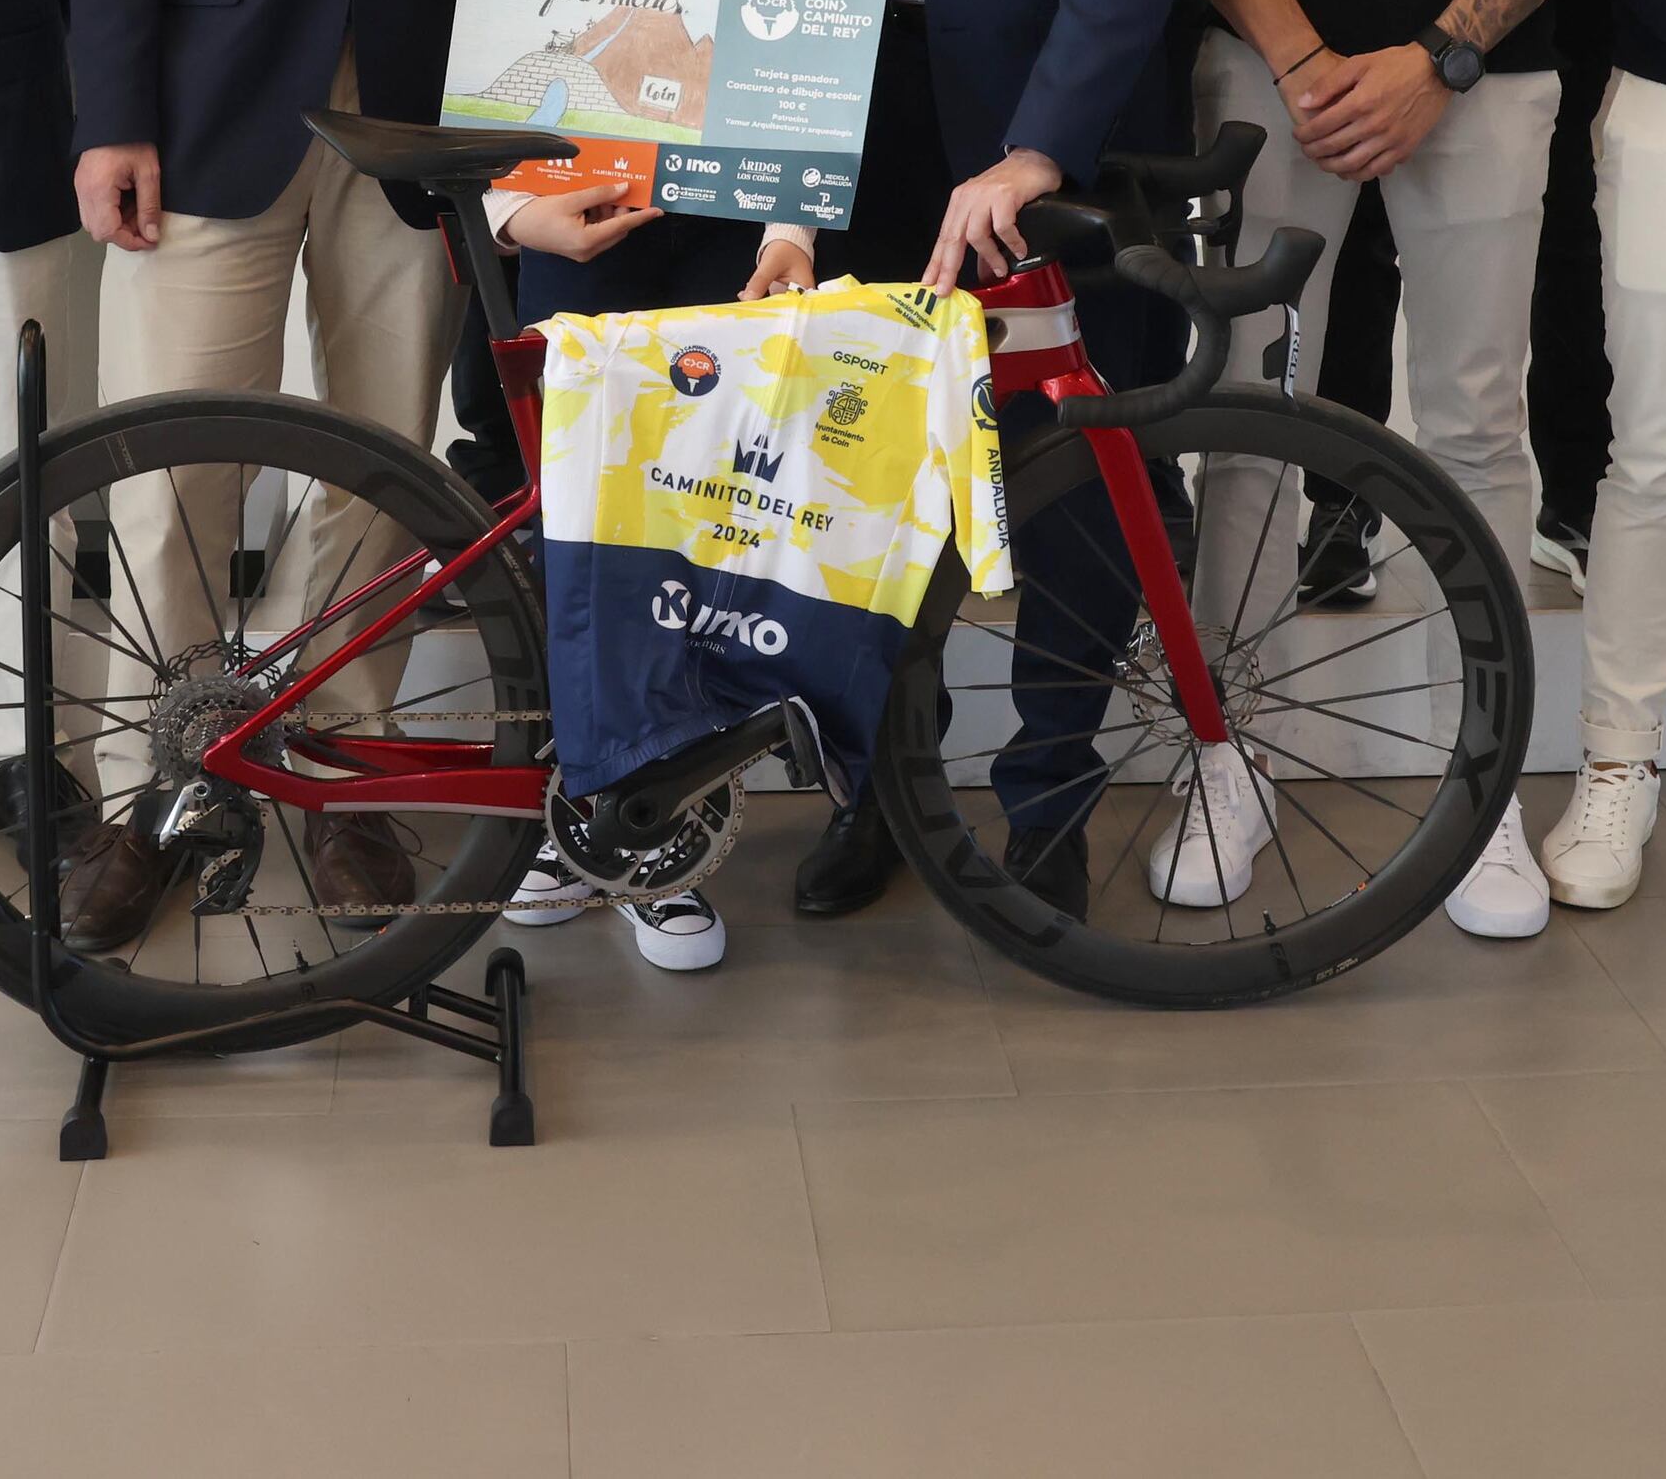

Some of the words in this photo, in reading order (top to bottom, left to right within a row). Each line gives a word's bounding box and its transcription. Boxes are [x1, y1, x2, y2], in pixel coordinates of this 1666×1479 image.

[803, 11, 873, 27] CAMINITO
[801, 24, 828, 36] DEL
[832, 26, 861, 39] REY
[753, 68, 789, 81] Tarjeta
[791, 73, 840, 86] ganadora
[726, 80, 775, 94] Concurso
[777, 86, 790, 95] de
[792, 86, 824, 99] dibujo
[825, 91, 862, 102] escolar
[779, 100, 796, 110] 100
[797, 102, 808, 111] €
[738, 157, 782, 173] ÁRIDOS
[736, 173, 751, 181] LOS
[833, 351, 889, 375] GSPORT
[820, 434, 830, 442] de
[651, 467, 752, 506] CAMINITO
[757, 494, 795, 520] DEL
[800, 510, 835, 532] REY
[987, 448, 1010, 550] ANDALUCIA
[712, 523, 761, 548] 2024
